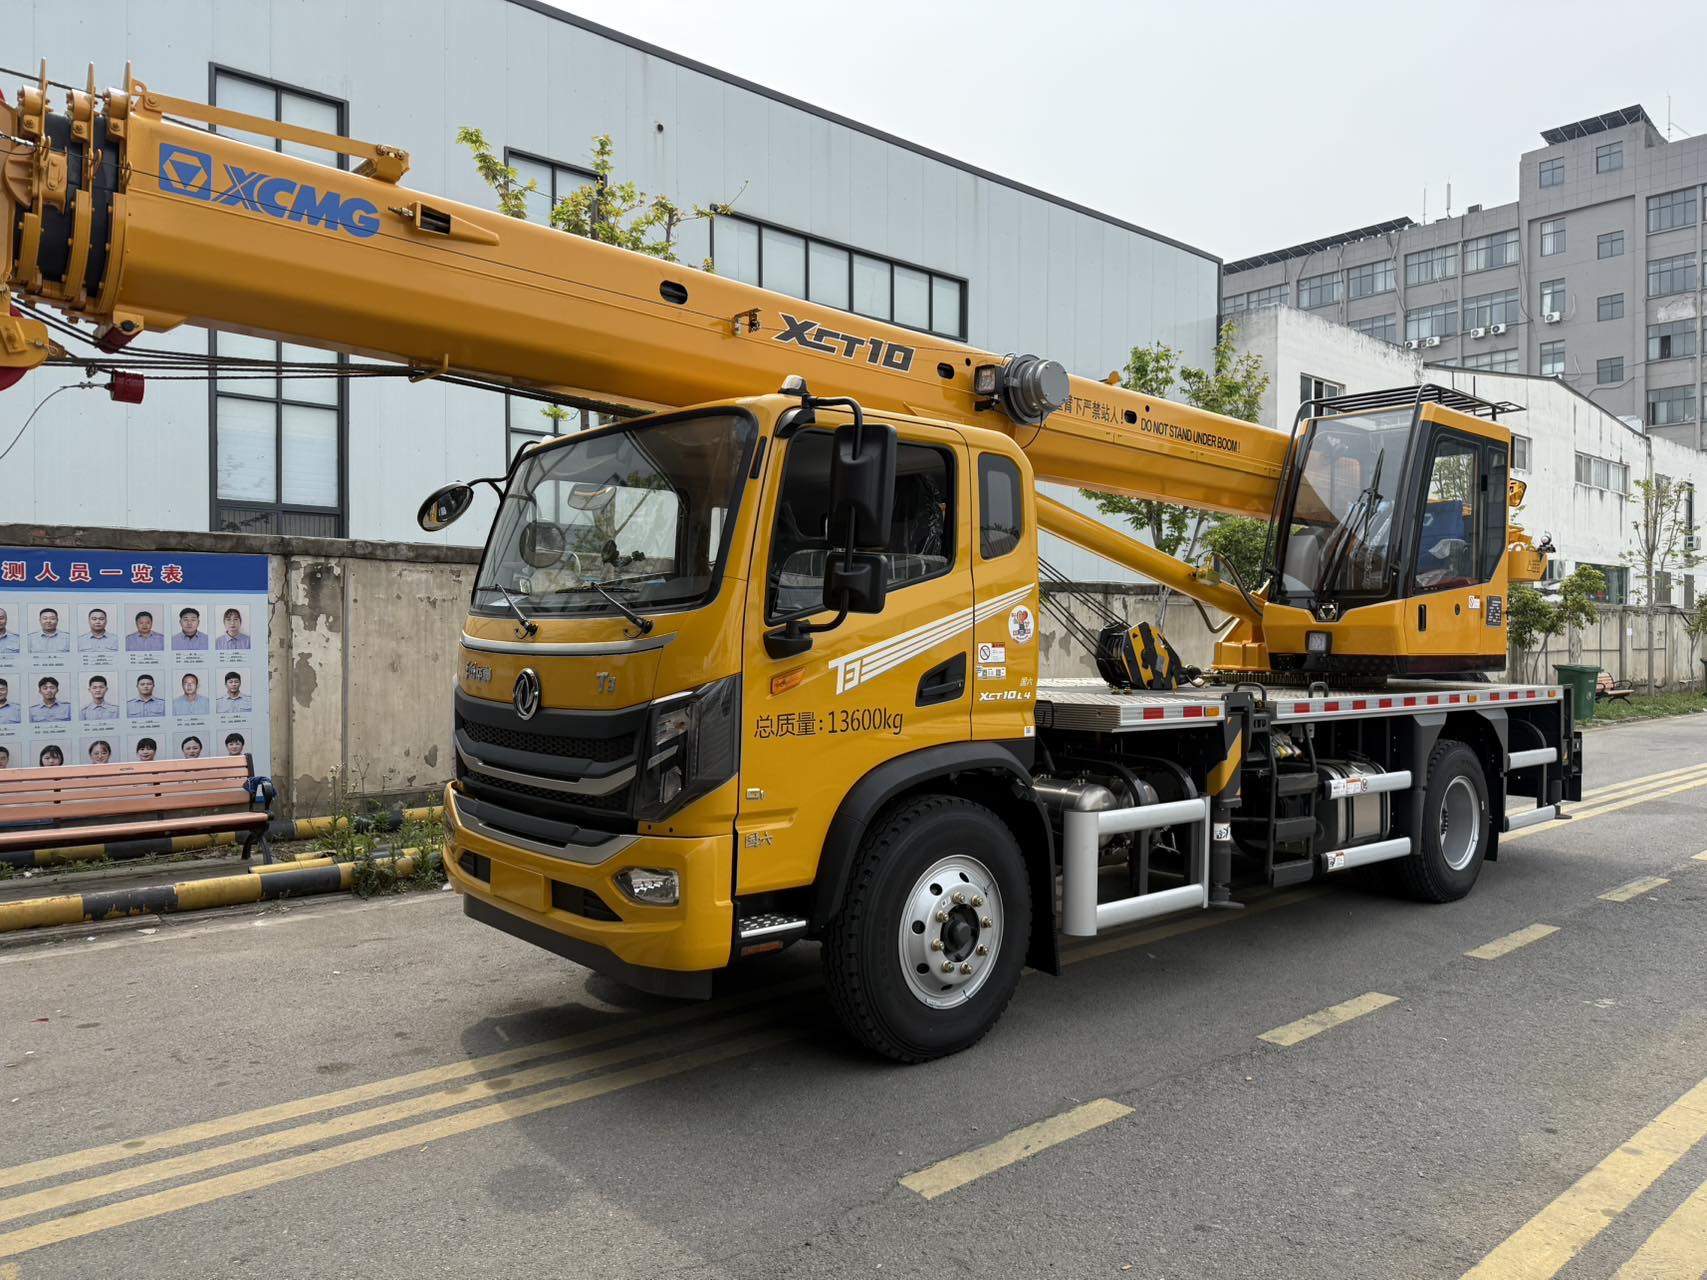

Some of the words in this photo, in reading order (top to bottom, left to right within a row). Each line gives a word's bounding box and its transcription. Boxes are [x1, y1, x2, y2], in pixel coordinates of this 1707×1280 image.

[211, 163, 381, 238] XCMG
[772, 312, 916, 373] XCT10
[1057, 395, 1124, 425] 臂下严禁站人!
[1141, 417, 1152, 431] DO
[1153, 421, 1169, 436] NOT
[1169, 424, 1192, 442] STAND
[1193, 431, 1216, 447] UNDER
[1, 560, 183, 583] 测人员一览表
